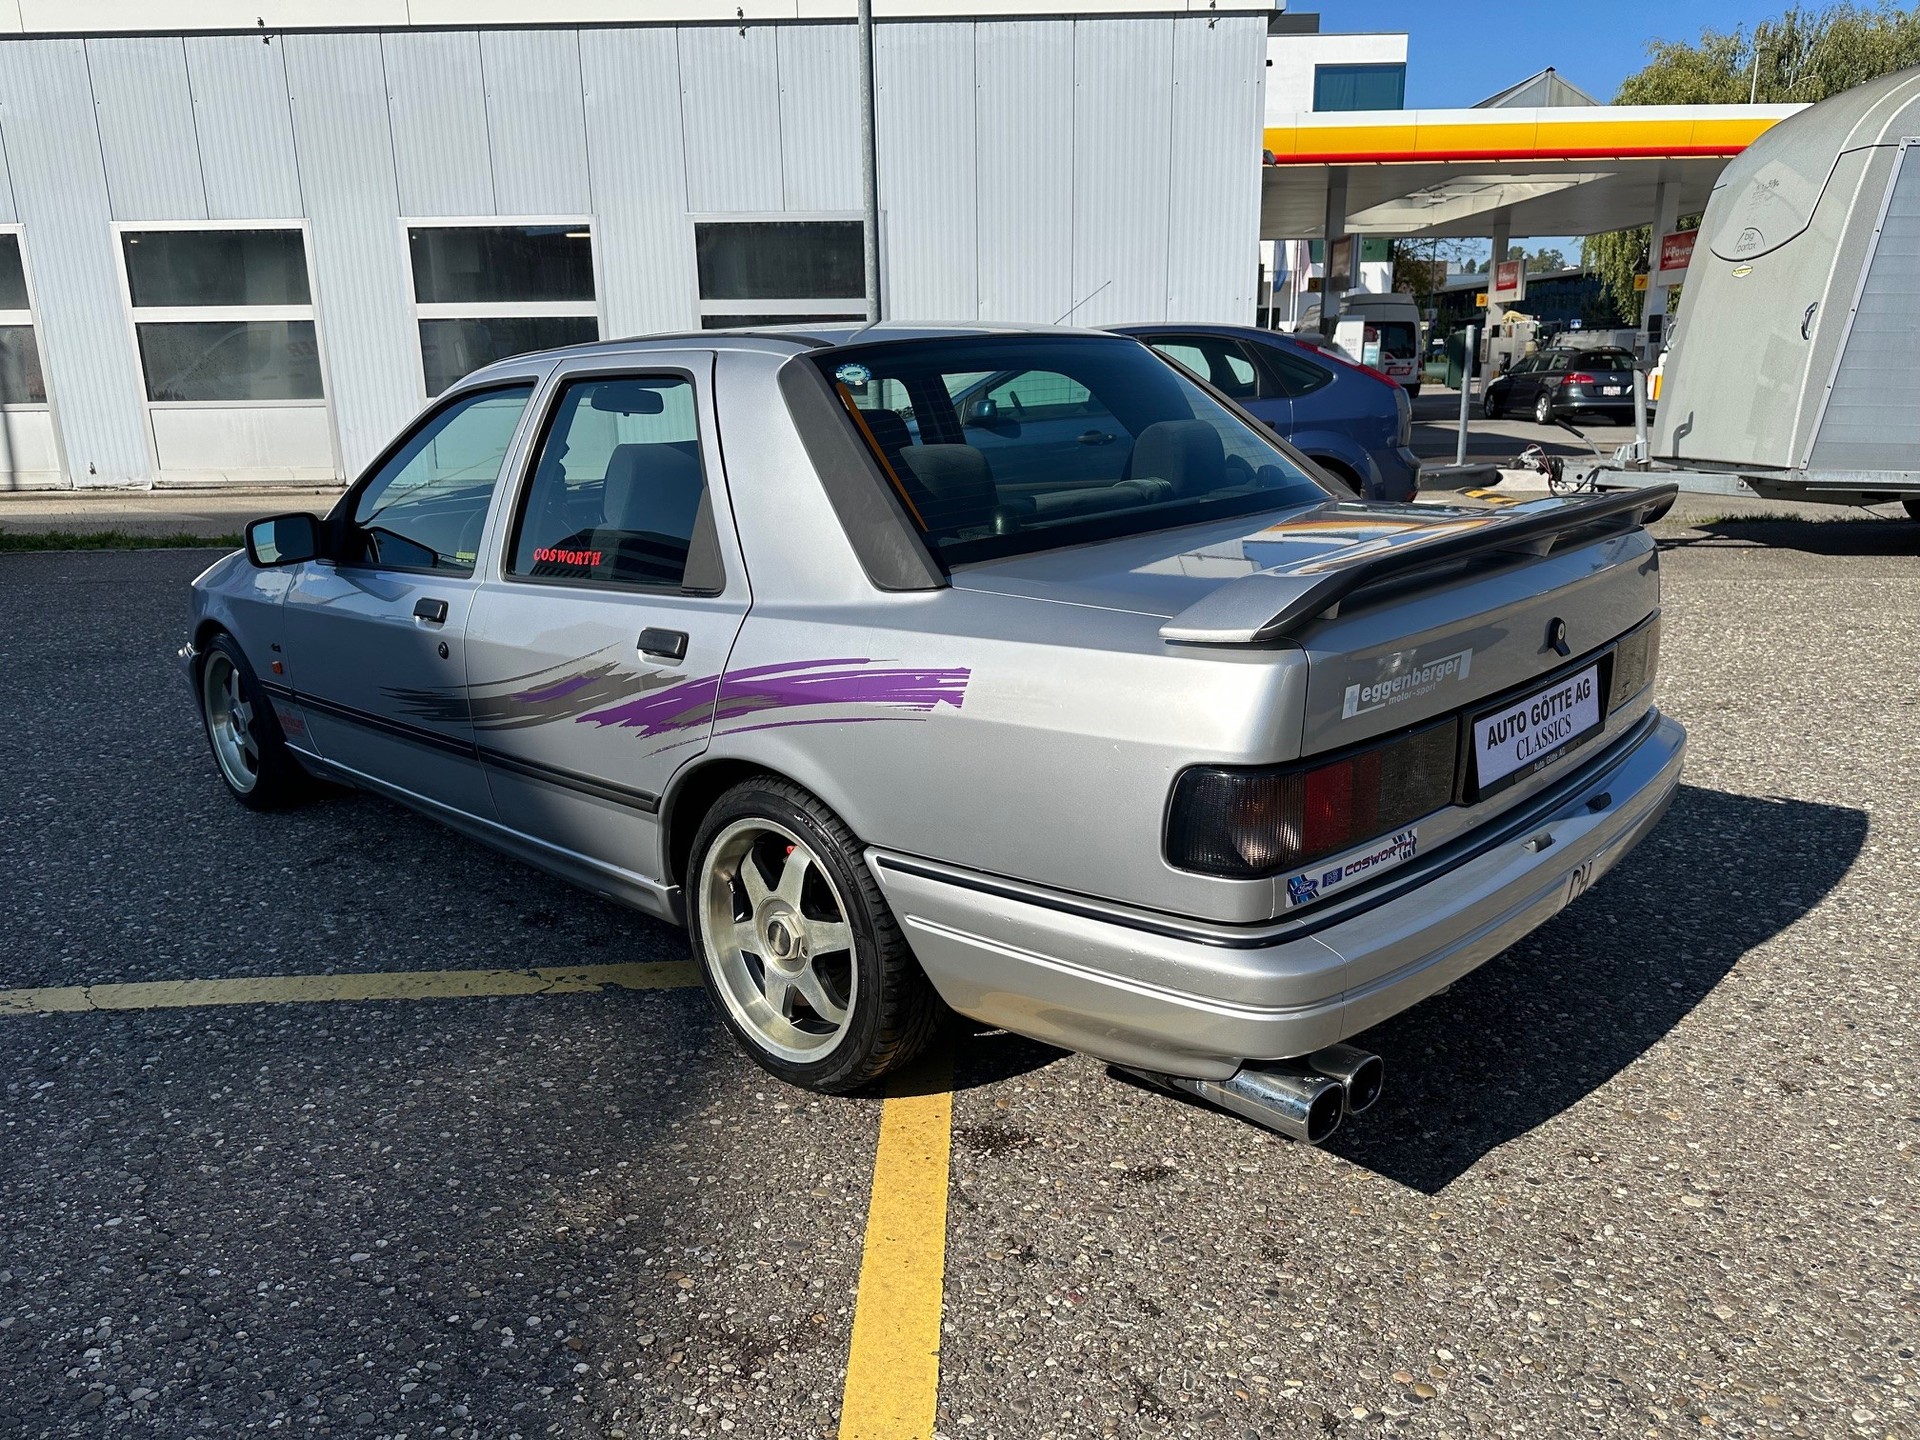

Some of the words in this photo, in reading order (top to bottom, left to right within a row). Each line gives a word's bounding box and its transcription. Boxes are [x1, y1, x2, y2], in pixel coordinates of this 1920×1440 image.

[1744, 232, 1755, 242] big
[1311, 281, 1318, 289] 3
[1638, 278, 1645, 287] 7
[533, 548, 602, 566] COSWORTH
[1361, 657, 1460, 703] eggenberger
[1388, 682, 1436, 705] motor-sport
[1487, 710, 1527, 751] AUTO
[1531, 686, 1573, 727] GÖTTE
[1575, 678, 1591, 704] AG
[1516, 713, 1572, 761] CLASSICS
[1344, 839, 1414, 877] COSWORTH
[1297, 883, 1314, 894] Ford
